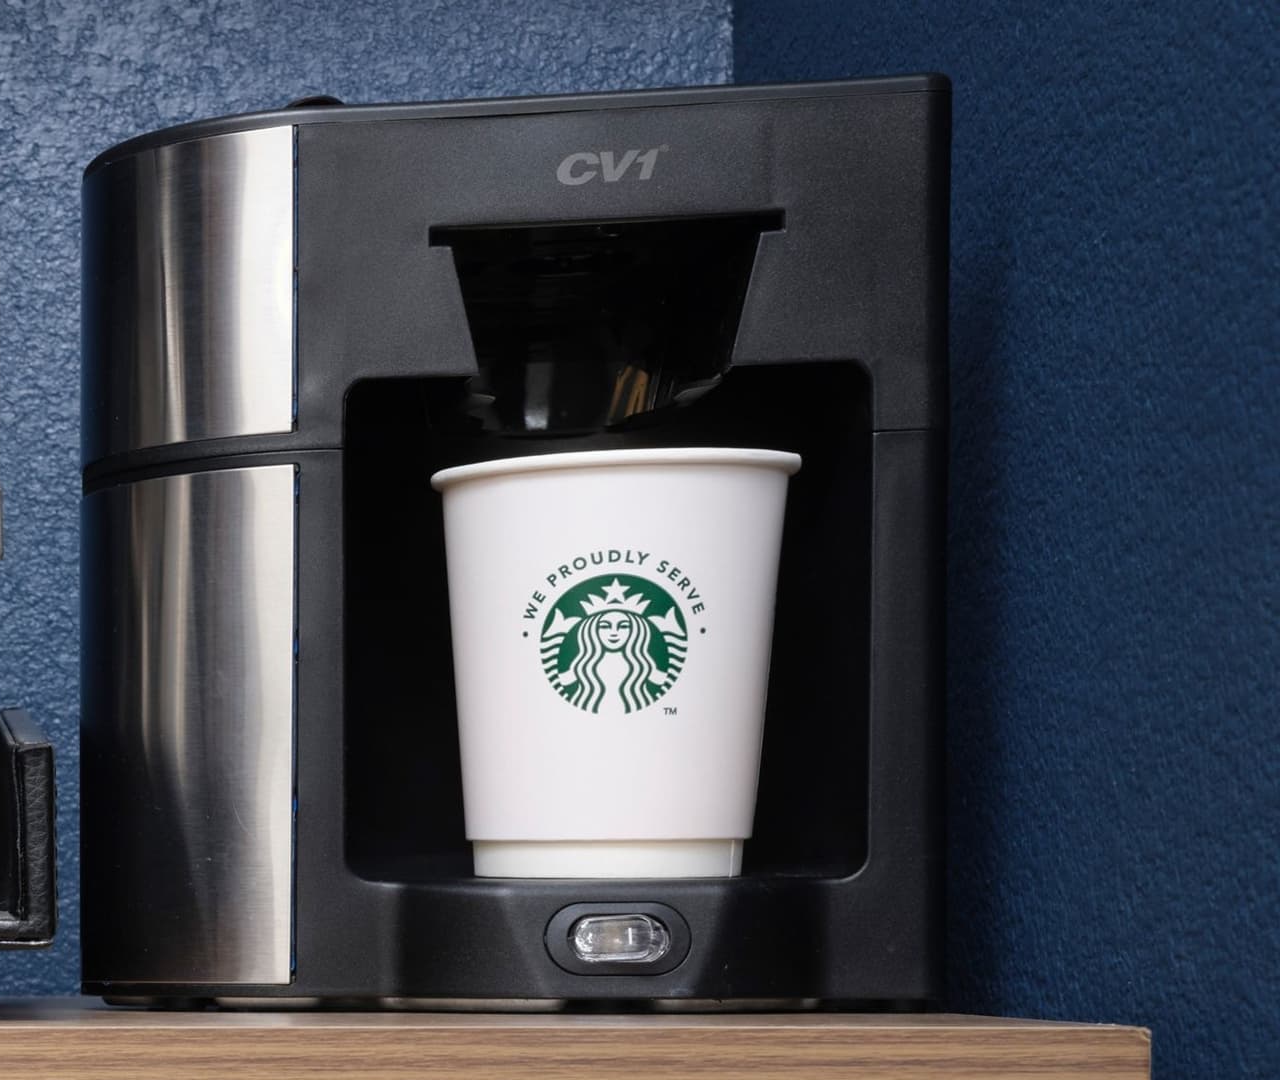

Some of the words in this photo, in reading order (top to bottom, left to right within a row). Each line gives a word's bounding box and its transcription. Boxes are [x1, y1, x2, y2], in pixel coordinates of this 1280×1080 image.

[556, 148, 660, 186] CV1
[523, 590, 547, 620] WE
[546, 549, 651, 588] PROUDLY
[655, 560, 706, 615] SERVE
